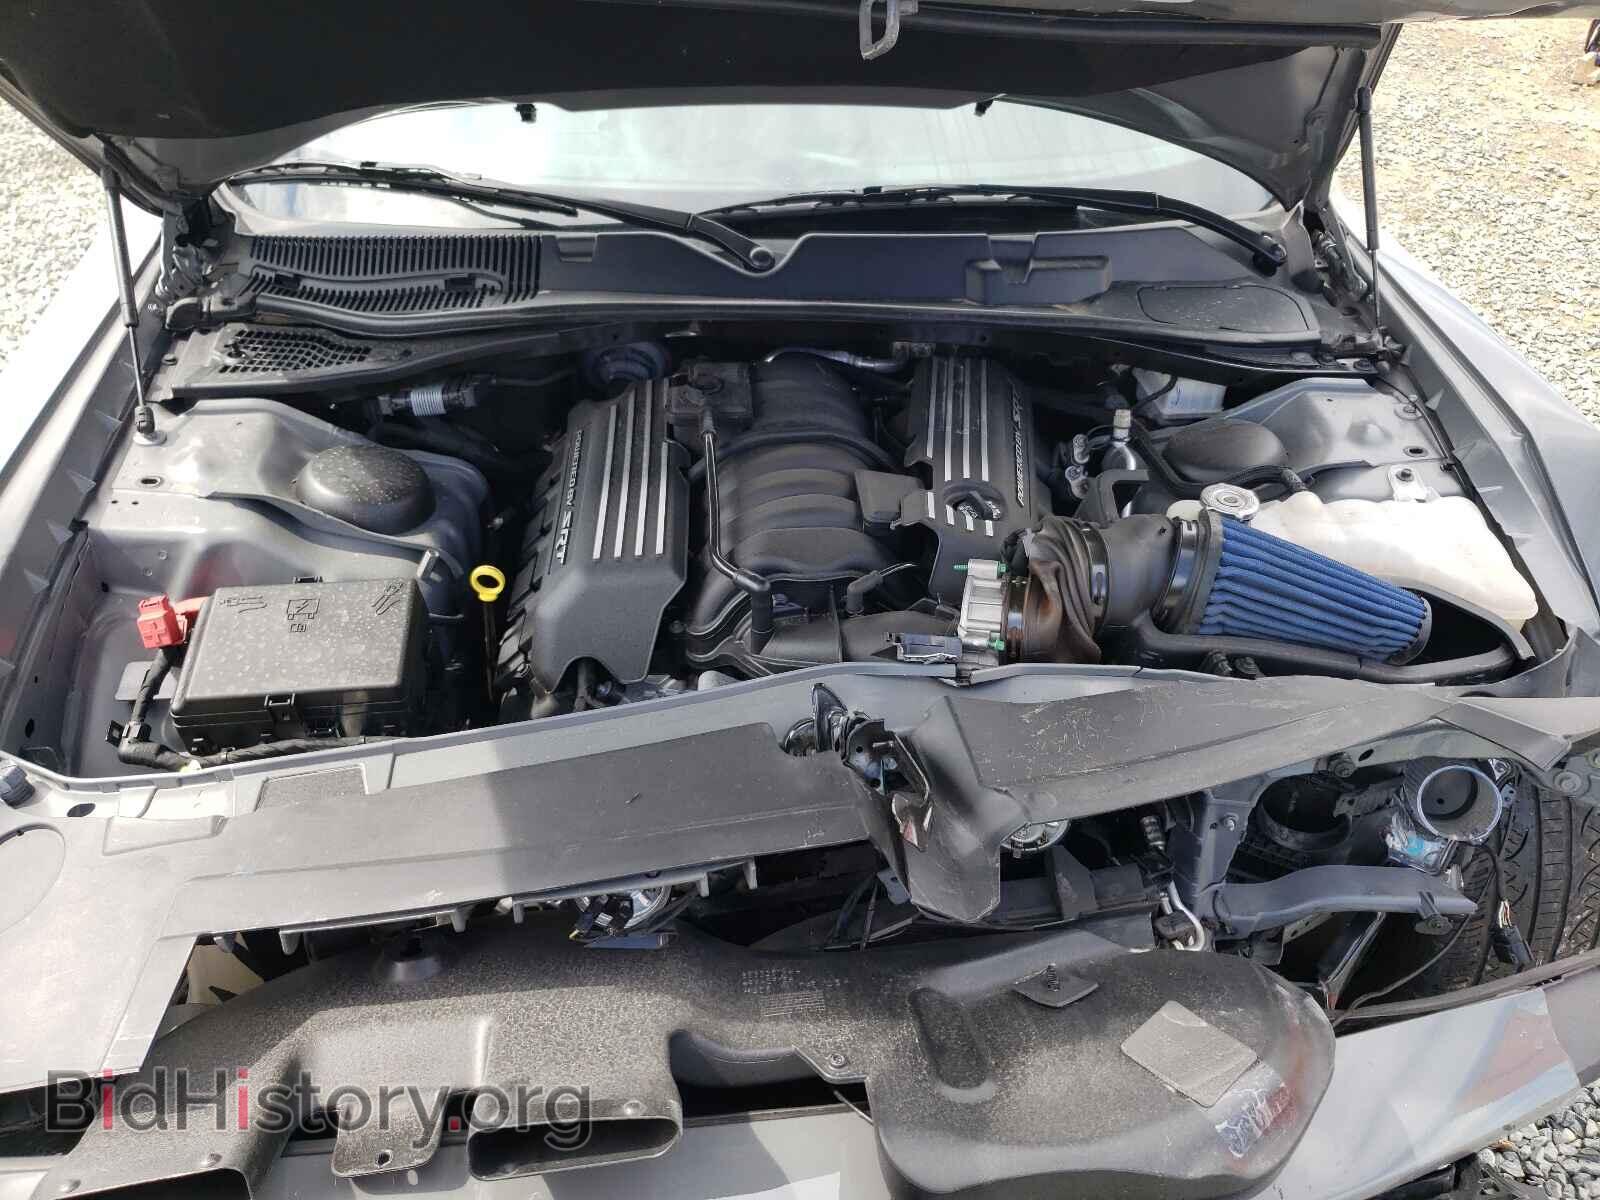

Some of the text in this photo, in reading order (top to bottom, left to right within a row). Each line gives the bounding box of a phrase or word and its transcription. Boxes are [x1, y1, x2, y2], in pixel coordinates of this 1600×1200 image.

[555, 430, 583, 565] POWERED BY SRT
